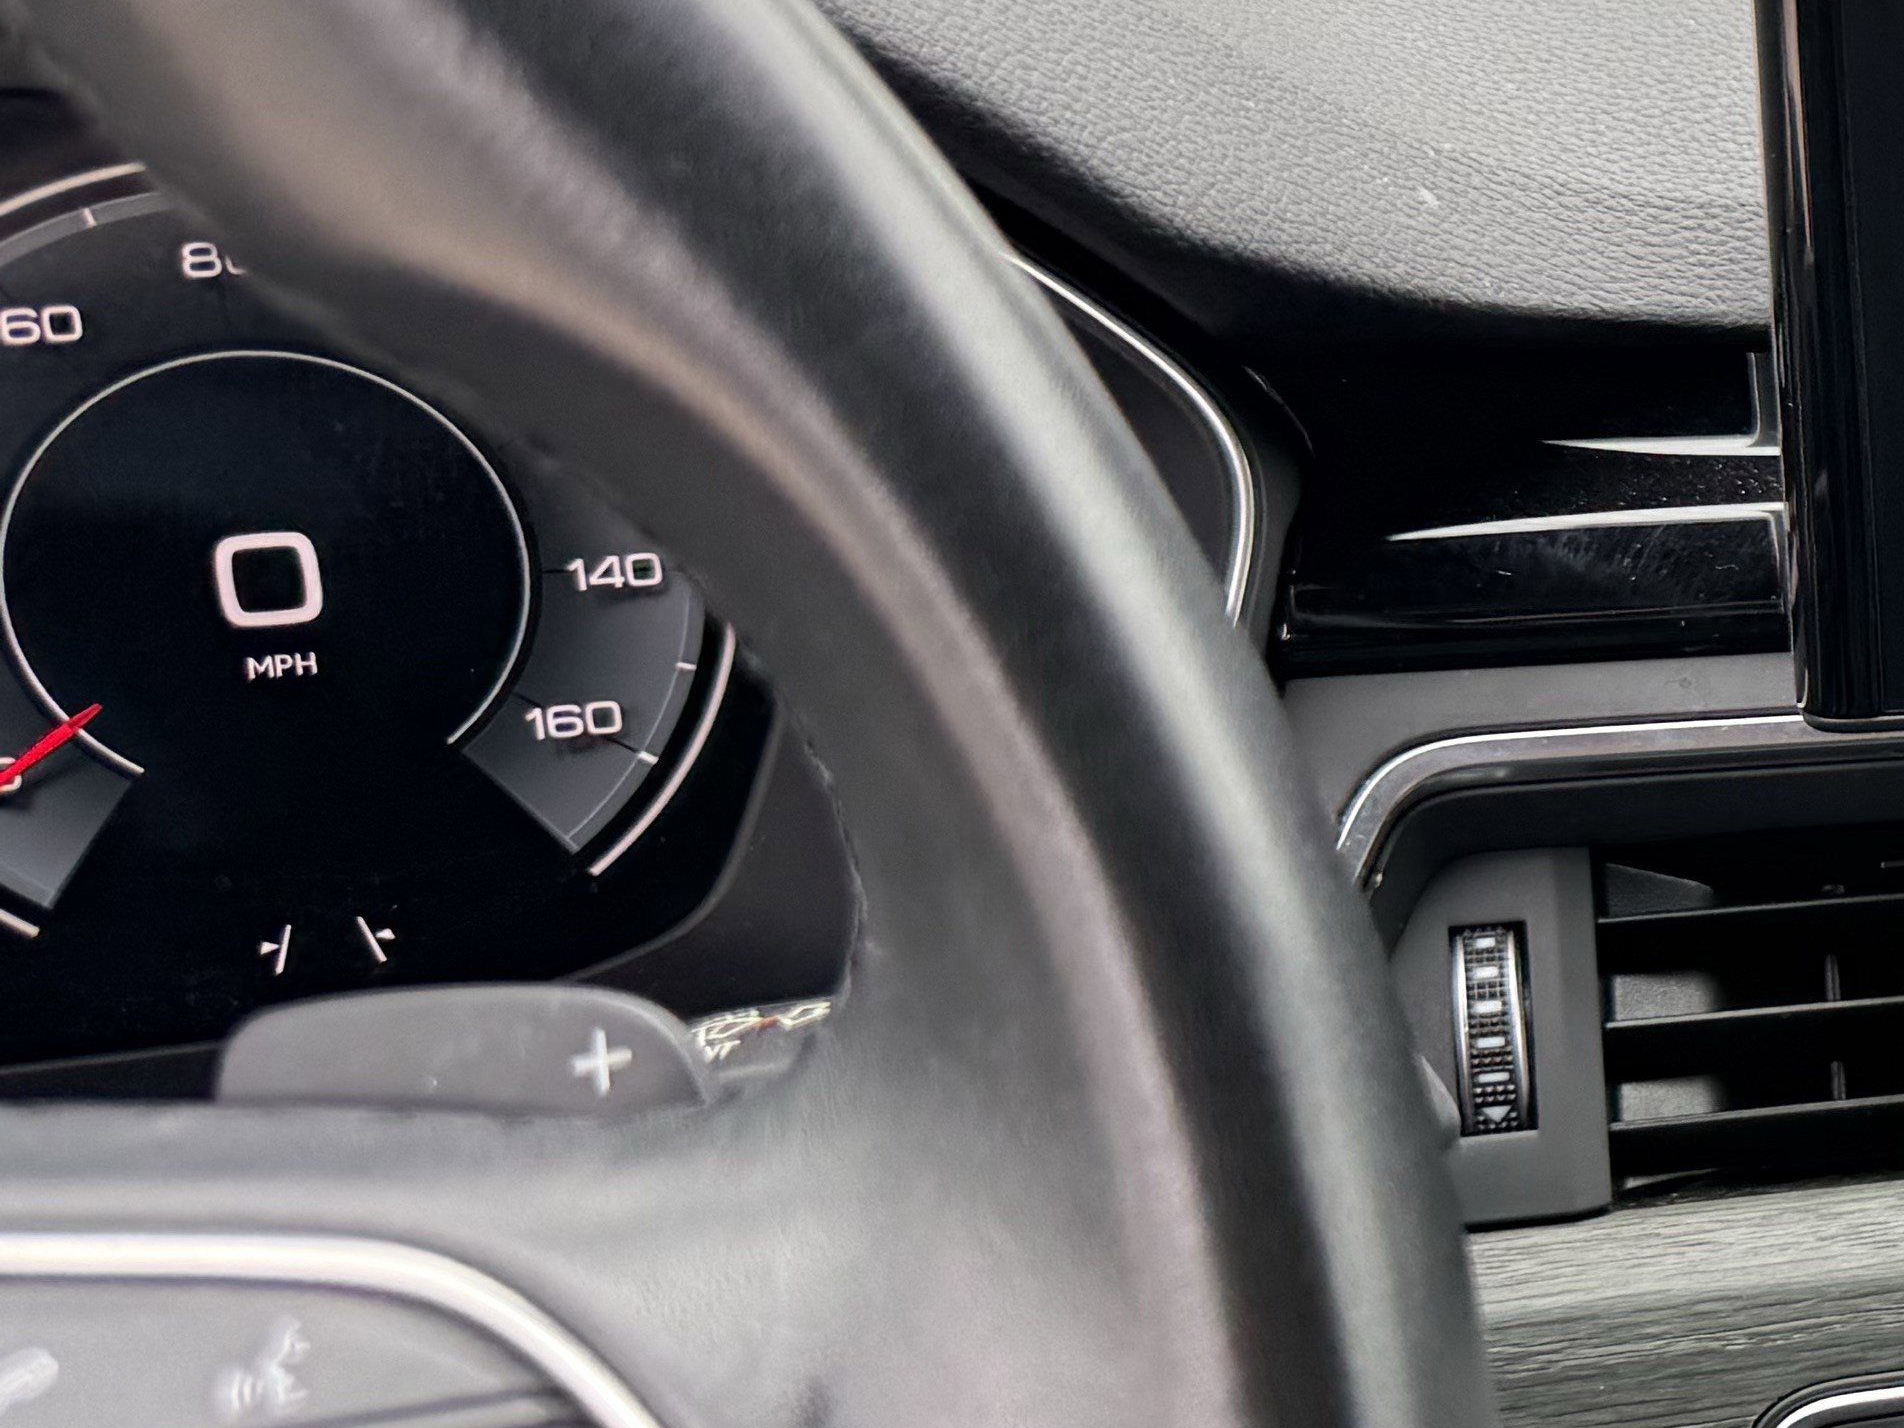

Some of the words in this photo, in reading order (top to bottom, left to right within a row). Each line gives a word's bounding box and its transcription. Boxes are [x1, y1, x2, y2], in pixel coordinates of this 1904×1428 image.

[181, 241, 248, 279] 8
[0, 304, 83, 346] 60
[214, 531, 323, 628] 0
[566, 551, 663, 592] 140
[246, 651, 318, 680] MPH
[524, 700, 623, 741] 160
